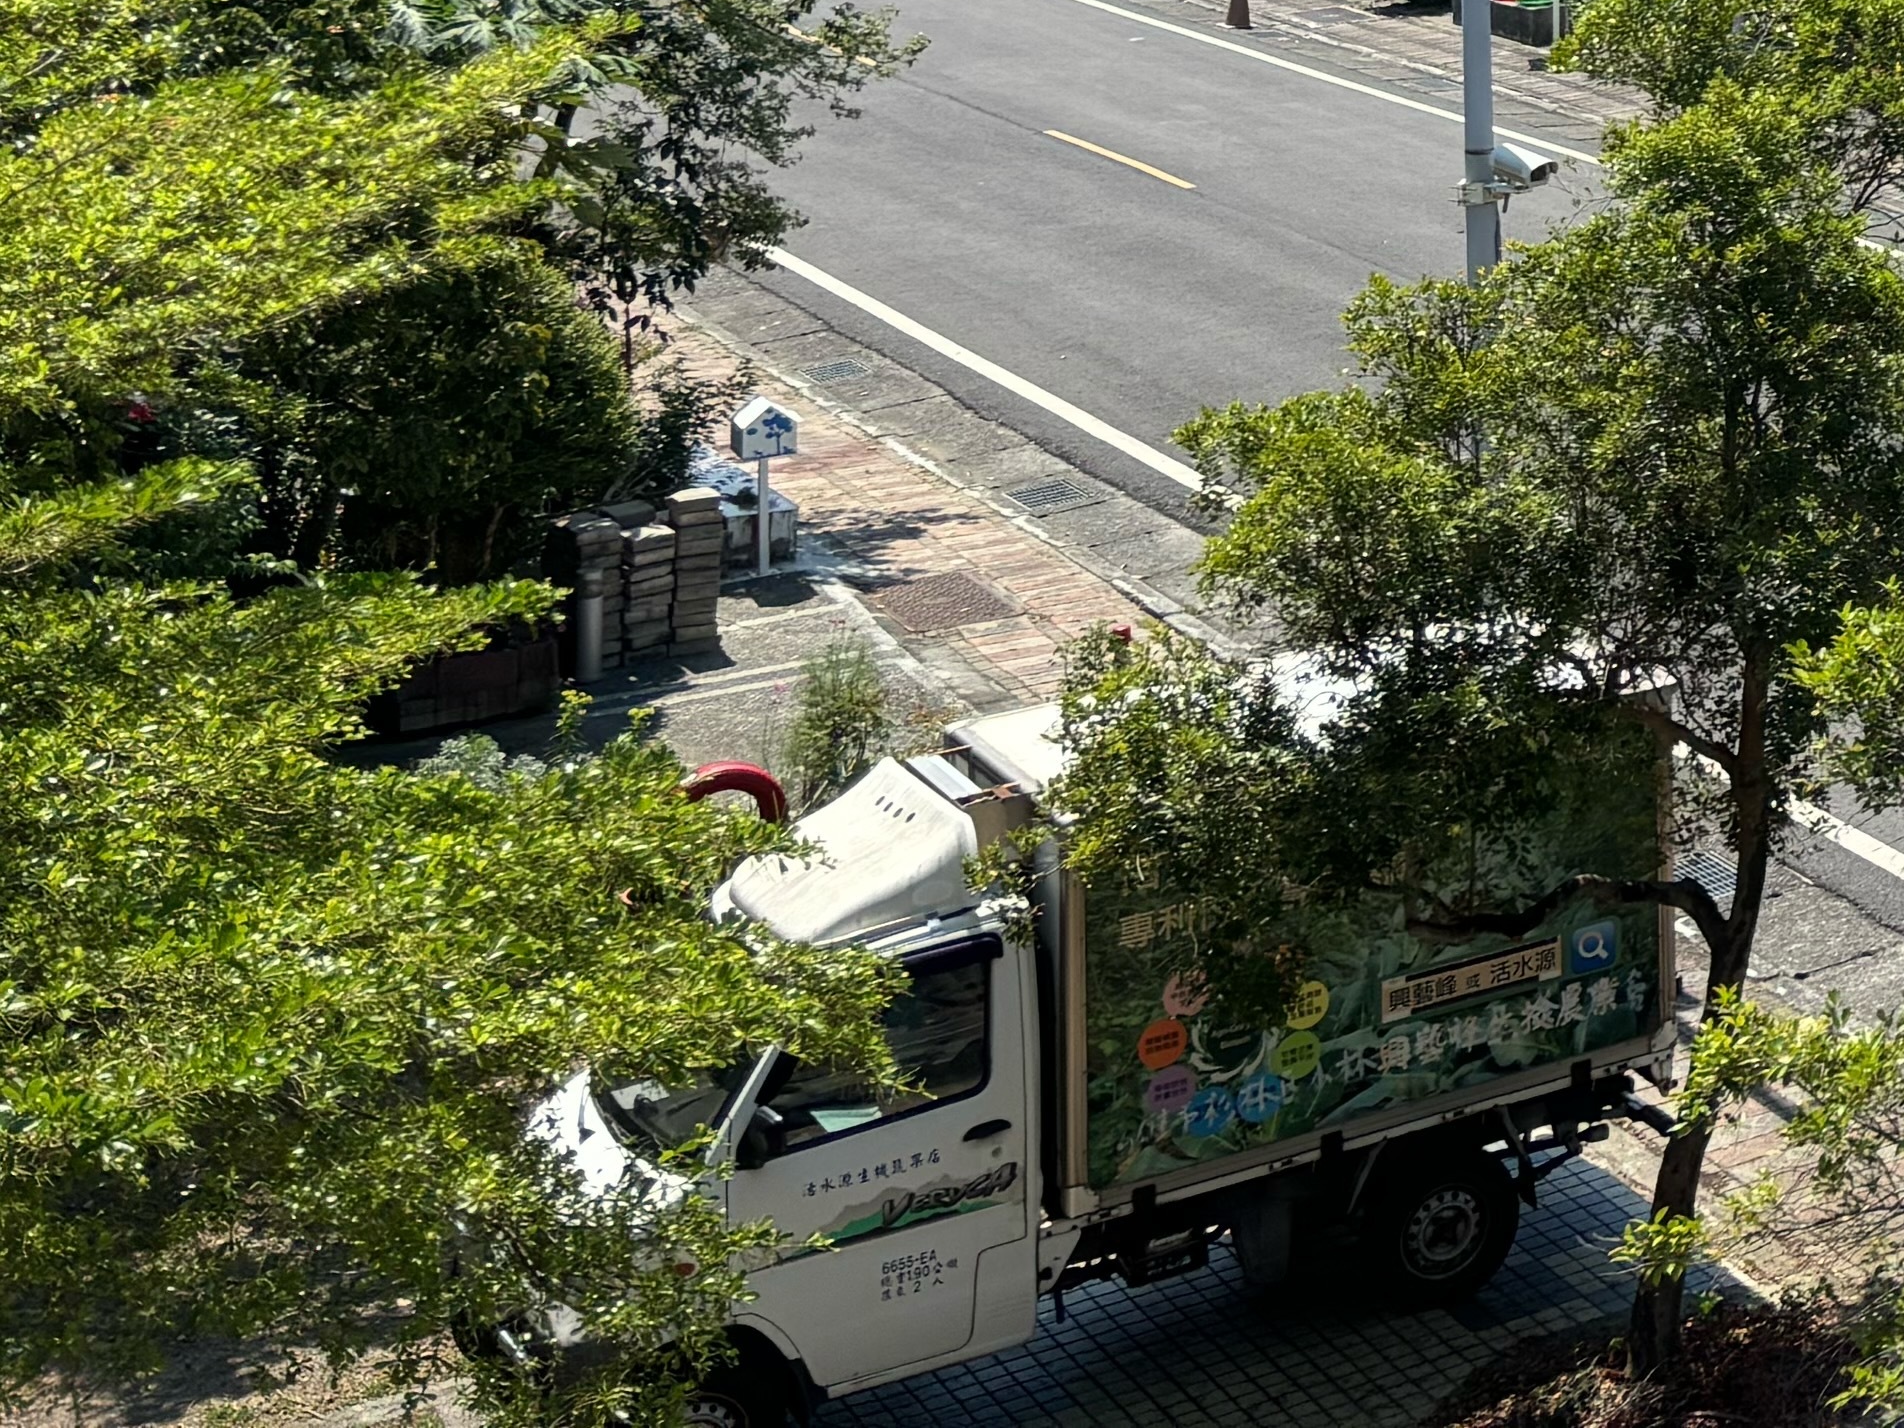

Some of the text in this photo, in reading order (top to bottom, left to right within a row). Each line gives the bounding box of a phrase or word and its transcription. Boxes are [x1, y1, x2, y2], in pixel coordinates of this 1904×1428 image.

[1490, 946, 1557, 983] 活水源
[882, 1249, 937, 1275] 6655-EA
